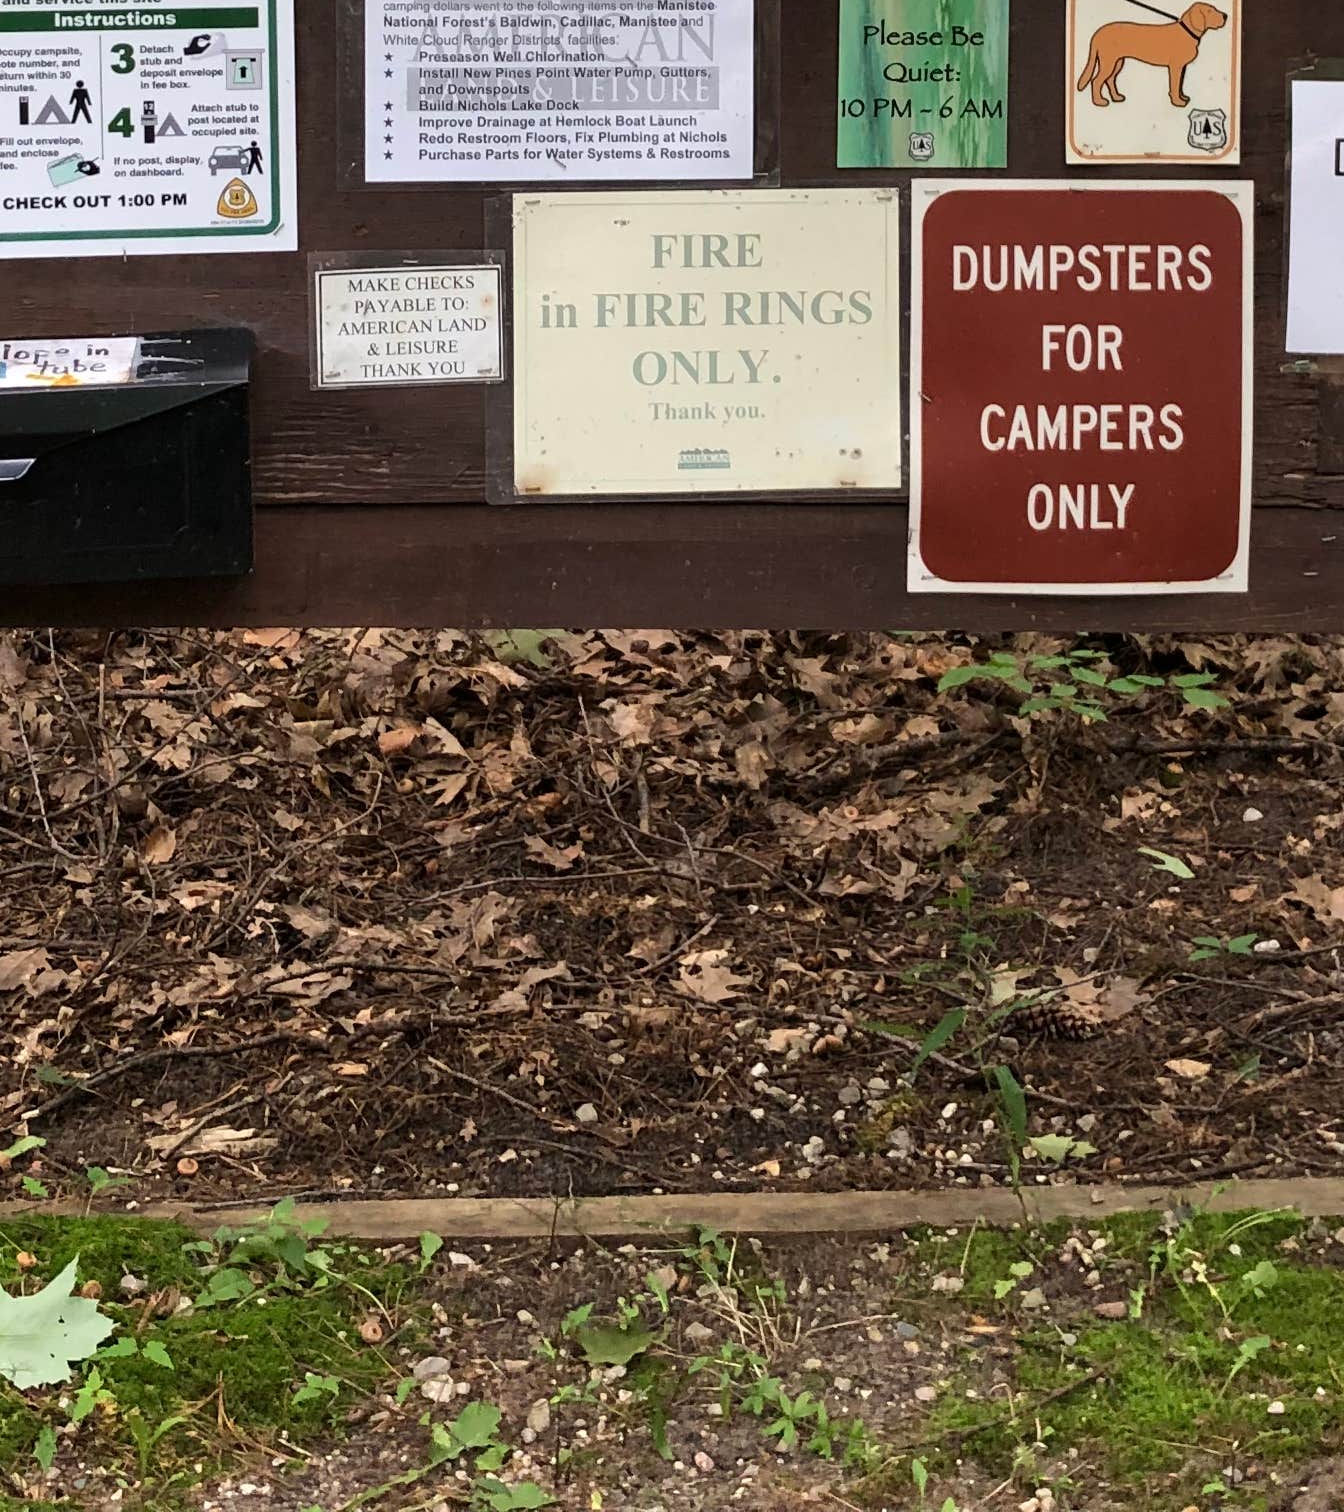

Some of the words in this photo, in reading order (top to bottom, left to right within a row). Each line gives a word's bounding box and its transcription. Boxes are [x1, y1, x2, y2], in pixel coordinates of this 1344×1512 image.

[54, 13, 177, 28] Instructions
[863, 20, 943, 46] Please
[951, 26, 984, 46] Be
[110, 43, 135, 74] 3
[883, 61, 961, 83] Quiet:
[191, 104, 223, 112] Attach
[226, 104, 246, 112] stub
[250, 104, 259, 112] to
[841, 99, 862, 118] 10
[874, 99, 912, 118] PM
[940, 97, 952, 118] 6
[961, 99, 1002, 118] AM
[108, 107, 134, 138] 4
[419, 116, 472, 129] Improve
[477, 116, 535, 129] Drainage
[540, 117, 552, 127] at
[556, 116, 611, 127] Hemlock
[616, 116, 646, 126] Boat
[650, 116, 697, 126] Launch
[419, 133, 453, 144] Redo
[458, 133, 521, 144] Restroom
[526, 132, 570, 144] Floors,
[576, 132, 594, 142] Fix
[598, 132, 659, 144] Plumbing
[664, 132, 676, 142] at
[680, 132, 727, 142] Nichols
[419, 149, 482, 160] Purchase
[486, 149, 519, 160] Parts
[524, 149, 542, 160] for
[546, 148, 583, 159] Water
[588, 148, 642, 161] Systems
[646, 148, 656, 159] &
[660, 148, 730, 159] Restrooms
[3, 196, 66, 210] CHECK
[73, 194, 111, 209] OUT
[118, 194, 154, 208] 1:00
[161, 193, 188, 206] PM
[650, 233, 762, 269] FIRE
[953, 244, 1212, 292] DUMPSTERS
[348, 277, 400, 293] MAKE
[405, 275, 474, 290] CHECKS
[354, 298, 438, 314] PAYABLE
[442, 298, 469, 311] TO:
[541, 293, 577, 328] in
[593, 292, 705, 327] FIRE
[723, 289, 872, 326] RINGS
[338, 319, 434, 335] AMERICAN
[438, 318, 486, 332] LAND
[87, 344, 109, 357] in
[367, 342, 381, 356] &
[386, 339, 457, 356] LEISURE
[1042, 324, 1123, 372] FOR
[37, 359, 107, 376] tube
[360, 363, 423, 378] THANK
[429, 361, 465, 375] YOU
[632, 348, 782, 385] ONLY.
[649, 402, 715, 421] Thank
[723, 406, 766, 425] you.
[980, 403, 1184, 452] CAMPERS
[1027, 484, 1135, 531] ONLY
